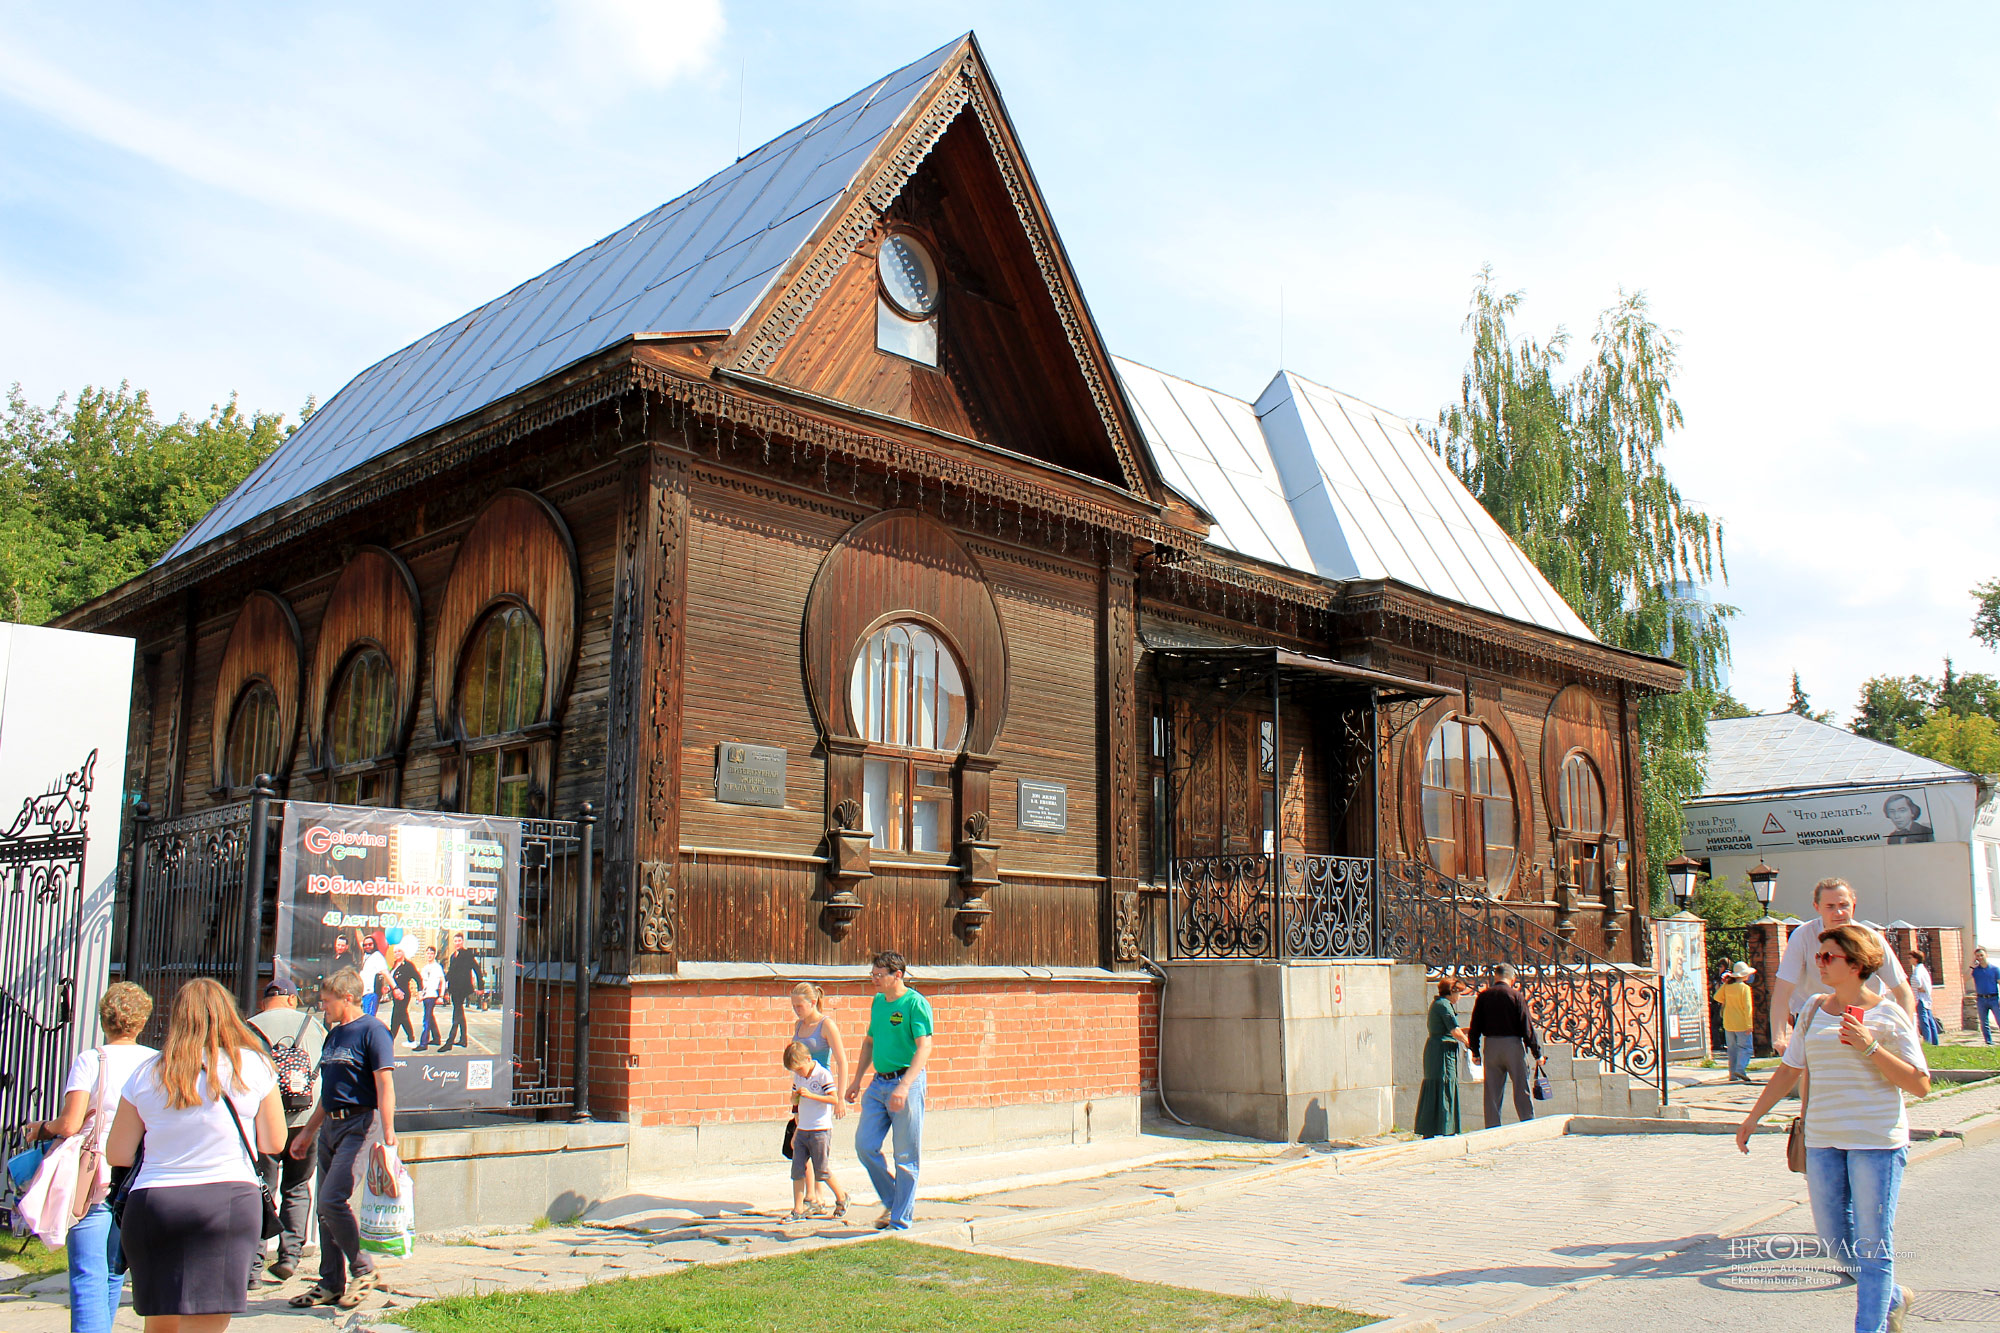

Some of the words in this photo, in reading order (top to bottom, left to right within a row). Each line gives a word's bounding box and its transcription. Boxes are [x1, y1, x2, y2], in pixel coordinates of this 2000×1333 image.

[1698, 819, 1710, 827] на
[1712, 816, 1735, 828] Руси
[305, 826, 387, 855] Golovina
[1707, 834, 1751, 845] НИКОЛАЙ
[1797, 828, 1844, 839] НИКОЛАЙ
[1798, 833, 1881, 846] ЧЕРНЫШЕВСКИЙ
[331, 845, 367, 861] Gang
[441, 840, 454, 852] 18
[456, 843, 503, 856] августа
[1705, 842, 1753, 852] НЕКРАСОВ
[308, 875, 420, 896] Юбилейный
[425, 884, 496, 903] концерт
[376, 899, 412, 913] «Мне
[414, 901, 435, 913] 75»
[322, 911, 342, 926] 45
[342, 914, 368, 928] лет
[368, 915, 380, 928] и
[380, 914, 397, 928] 30
[398, 916, 420, 928] лет
[424, 918, 440, 928] на
[441, 918, 482, 931] сцене
[421, 1064, 461, 1088] Karpov
